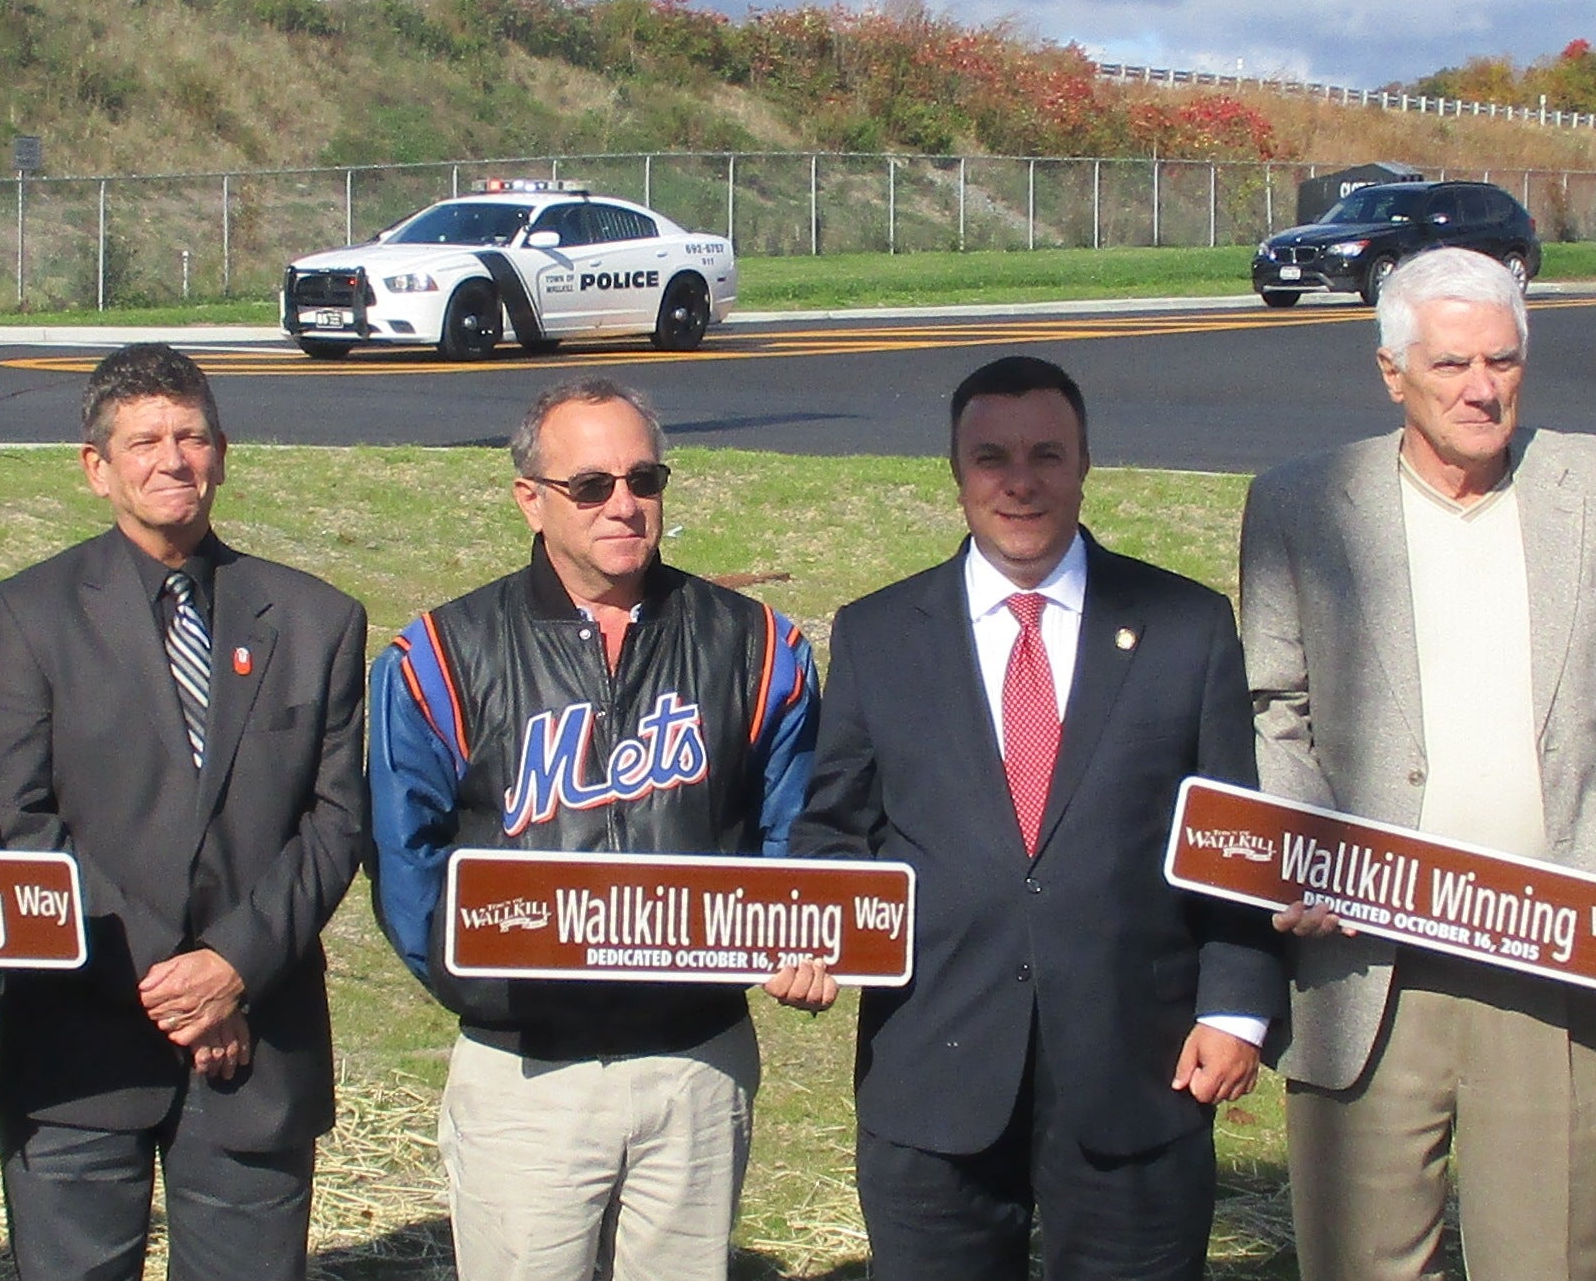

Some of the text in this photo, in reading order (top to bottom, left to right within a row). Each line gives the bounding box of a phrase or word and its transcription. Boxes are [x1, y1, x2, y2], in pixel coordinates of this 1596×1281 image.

[580, 271, 659, 291] POLICE
[504, 692, 709, 837] Mets
[14, 884, 69, 926] Way
[1281, 831, 1419, 911] Wallkill
[1430, 868, 1577, 963] Winning
[556, 885, 904, 966] Wallkill Winning Way
[1394, 913, 1470, 947] OCTOBER
[1472, 931, 1498, 954] 16,
[1500, 936, 1539, 961] 2015
[586, 948, 671, 967] DEDICATED
[676, 949, 748, 968] OCTOBER
[752, 951, 774, 971] 16,
